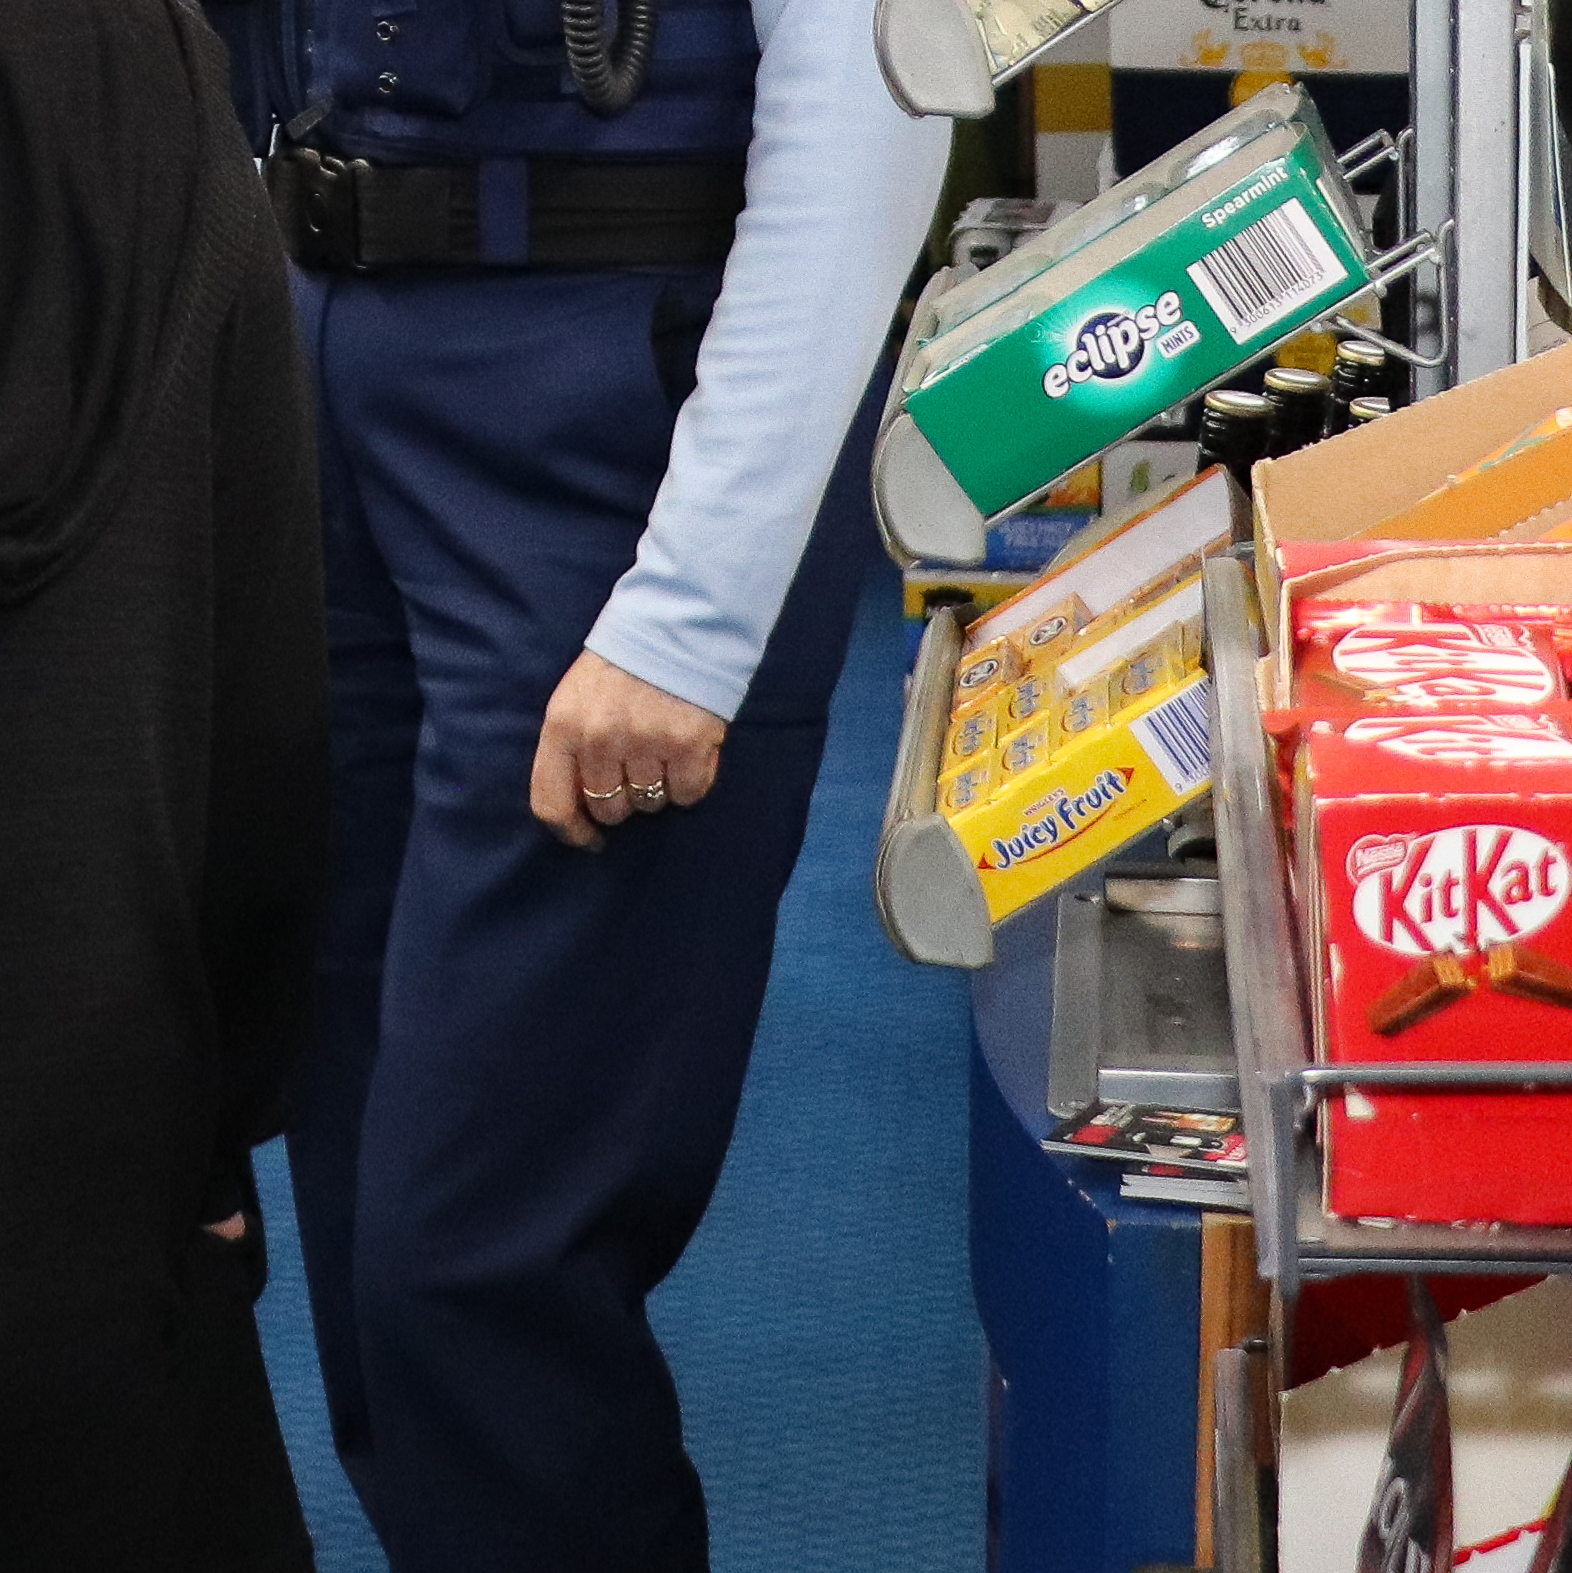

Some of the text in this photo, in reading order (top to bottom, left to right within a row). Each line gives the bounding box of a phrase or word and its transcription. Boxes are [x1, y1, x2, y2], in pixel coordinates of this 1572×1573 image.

[1233, 6, 1301, 31] Extra
[1201, 166, 1289, 228] Spearmint
[1042, 290, 1183, 399] eclipse
[1160, 324, 1195, 354] MINTS
[991, 813, 1059, 870] Juicy
[1054, 769, 1127, 830] Fruit
[1377, 827, 1558, 952] KitKat
